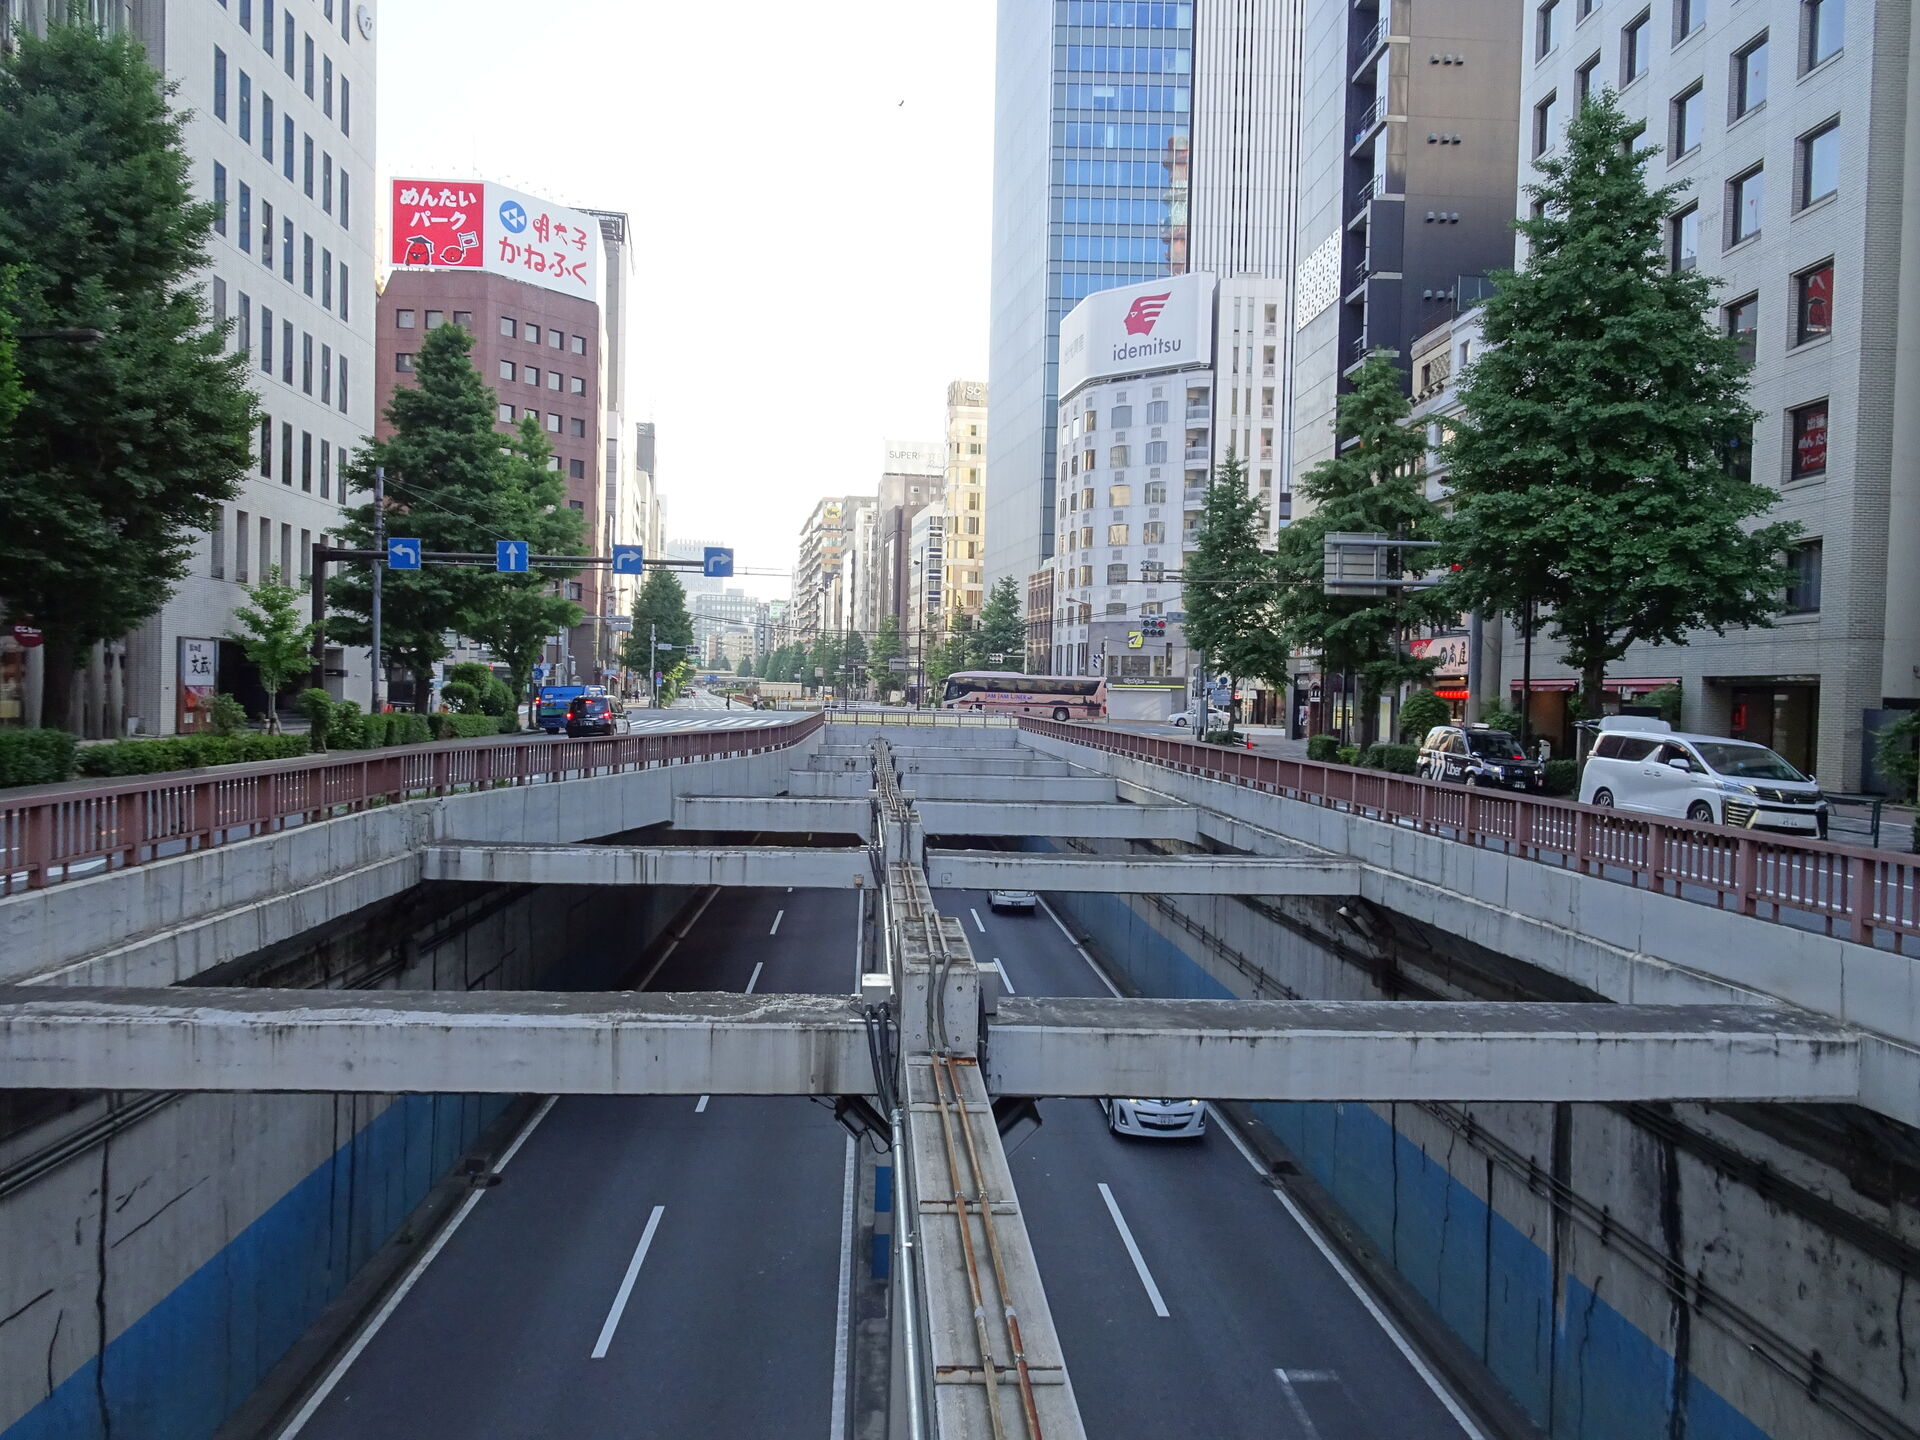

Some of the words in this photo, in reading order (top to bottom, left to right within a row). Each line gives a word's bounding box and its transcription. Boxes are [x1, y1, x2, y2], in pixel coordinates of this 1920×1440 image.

[400, 187, 477, 207] めんたい
[409, 211, 468, 231] パーク
[532, 212, 587, 252] 明太子
[498, 236, 588, 286] かねふく
[1113, 337, 1182, 361] idemitsu
[888, 450, 918, 460] SUPER
[1446, 762, 1462, 776] Uber
